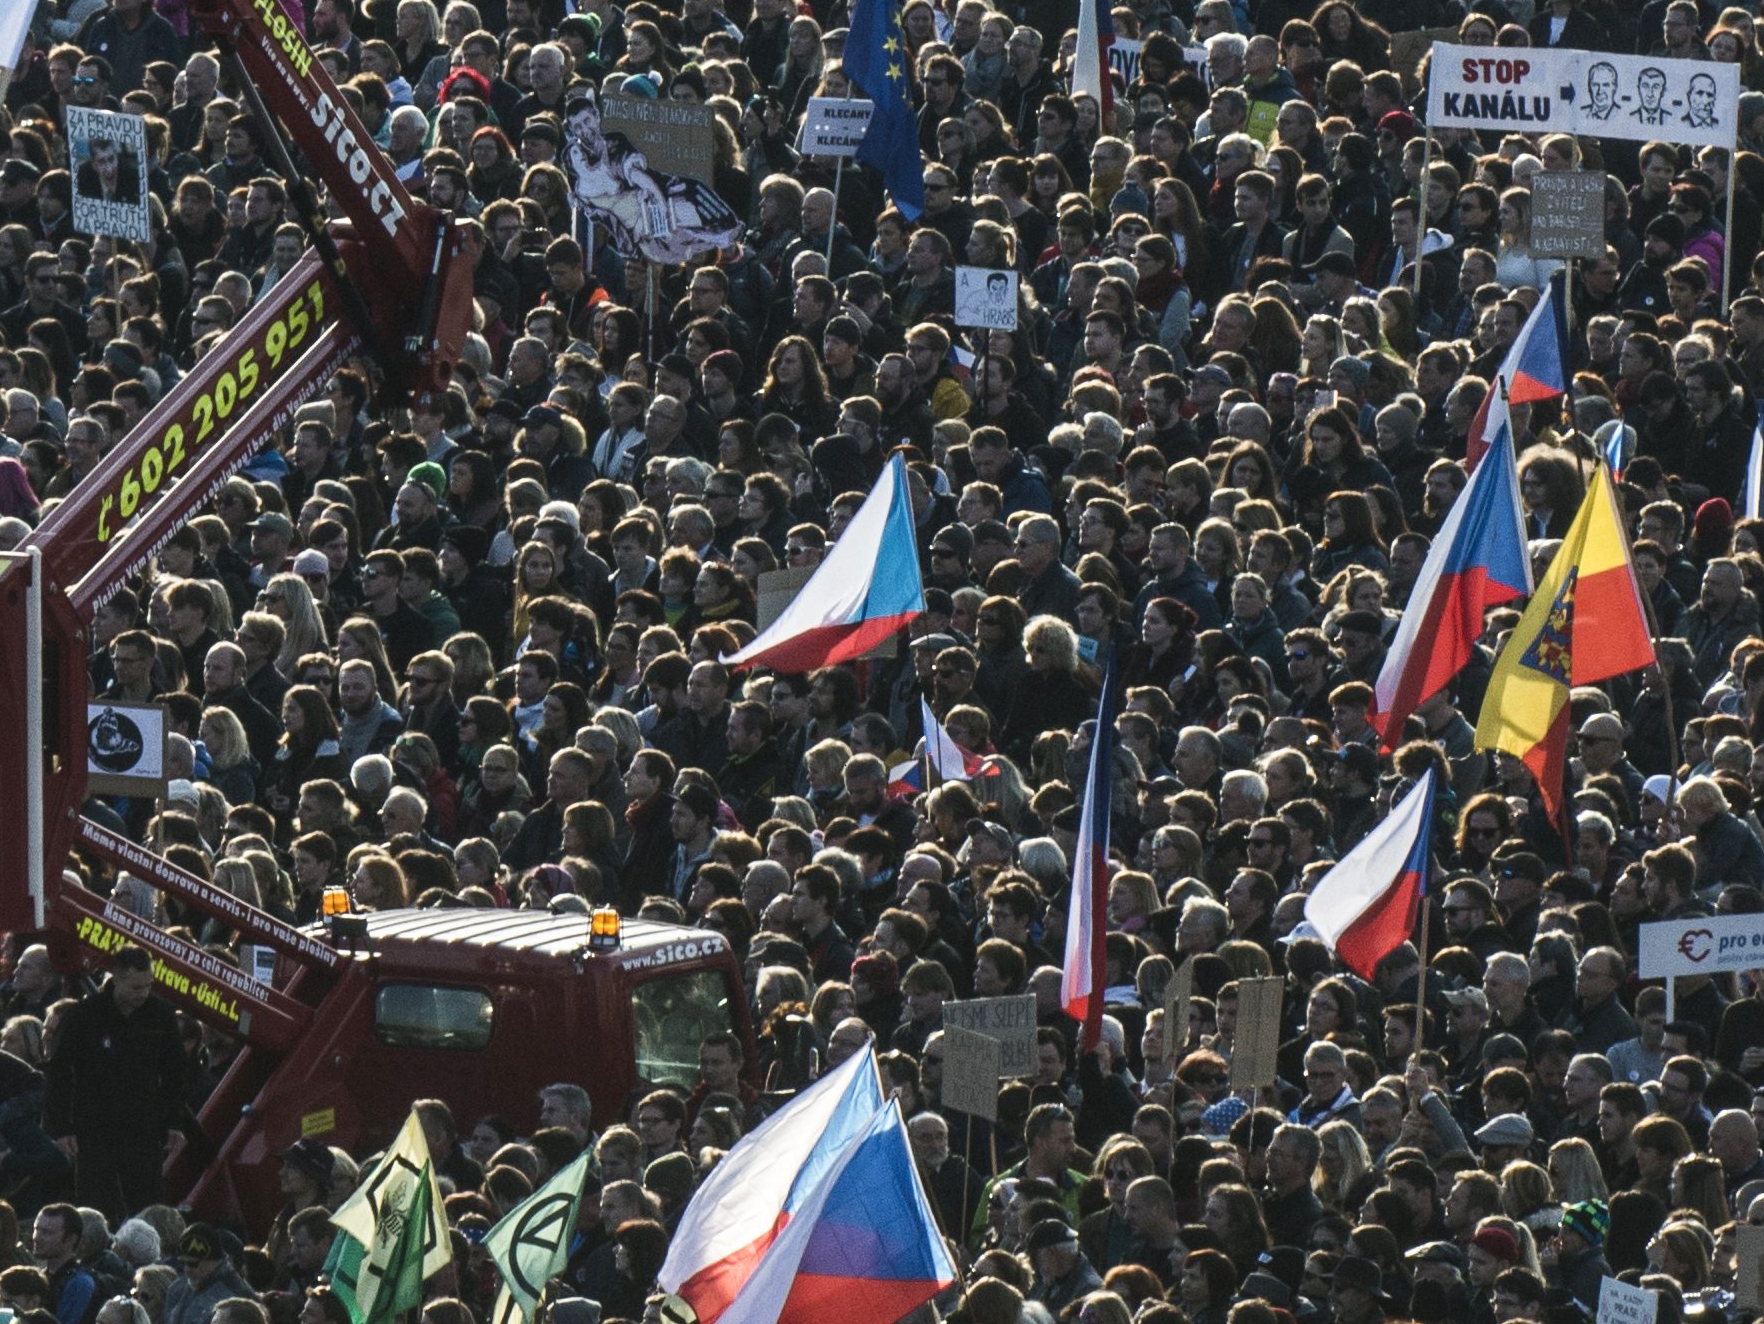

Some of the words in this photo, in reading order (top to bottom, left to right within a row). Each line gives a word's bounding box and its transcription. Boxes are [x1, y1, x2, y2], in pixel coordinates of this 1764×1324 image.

[1461, 58, 1531, 85] STOP
[824, 107, 871, 120] KLECANY
[1443, 89, 1551, 123] KANÁLU
[87, 112, 143, 135] PRAVDU
[310, 92, 406, 239] sico.cz
[102, 206, 147, 227] TRUTH
[95, 222, 149, 243] PRAVDU
[120, 422, 187, 519] 602
[191, 347, 261, 446] 205
[264, 279, 325, 369] 951
[82, 823, 116, 853] Máme
[118, 842, 154, 871] vlastní
[155, 859, 199, 898] dopravu
[208, 892, 241, 919] servis
[252, 916, 272, 935] pro
[132, 919, 187, 962] provozovny
[621, 937, 725, 972] www.sico.cz
[1719, 933, 1747, 953] pro
